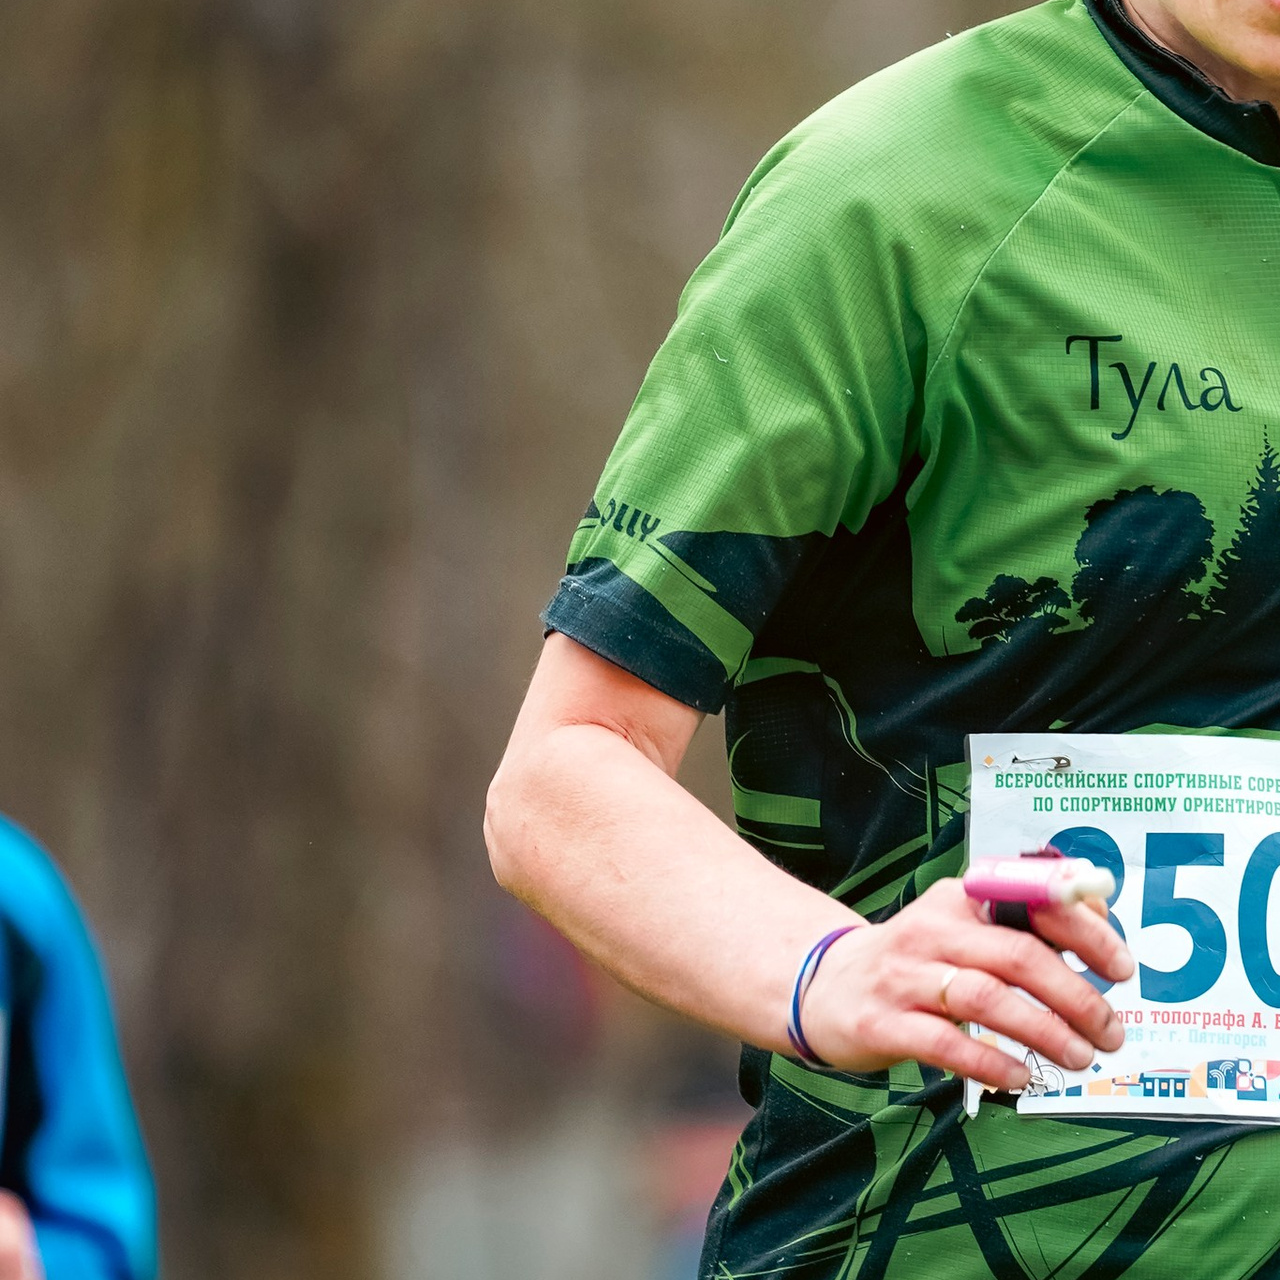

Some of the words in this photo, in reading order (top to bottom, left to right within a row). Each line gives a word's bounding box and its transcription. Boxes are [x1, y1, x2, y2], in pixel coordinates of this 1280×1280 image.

[1066, 334, 1243, 440] Тула
[995, 770, 1128, 789] ВСЕРОССИЙСКИЕ
[1133, 772, 1242, 791] СПОРТИВНЫЕ
[1033, 796, 1054, 812] ПО
[1060, 796, 1177, 812] СПОРТИВНОМУ
[1150, 1009, 1245, 1031] топографа
[1188, 1029, 1267, 1048] Пятигорск
